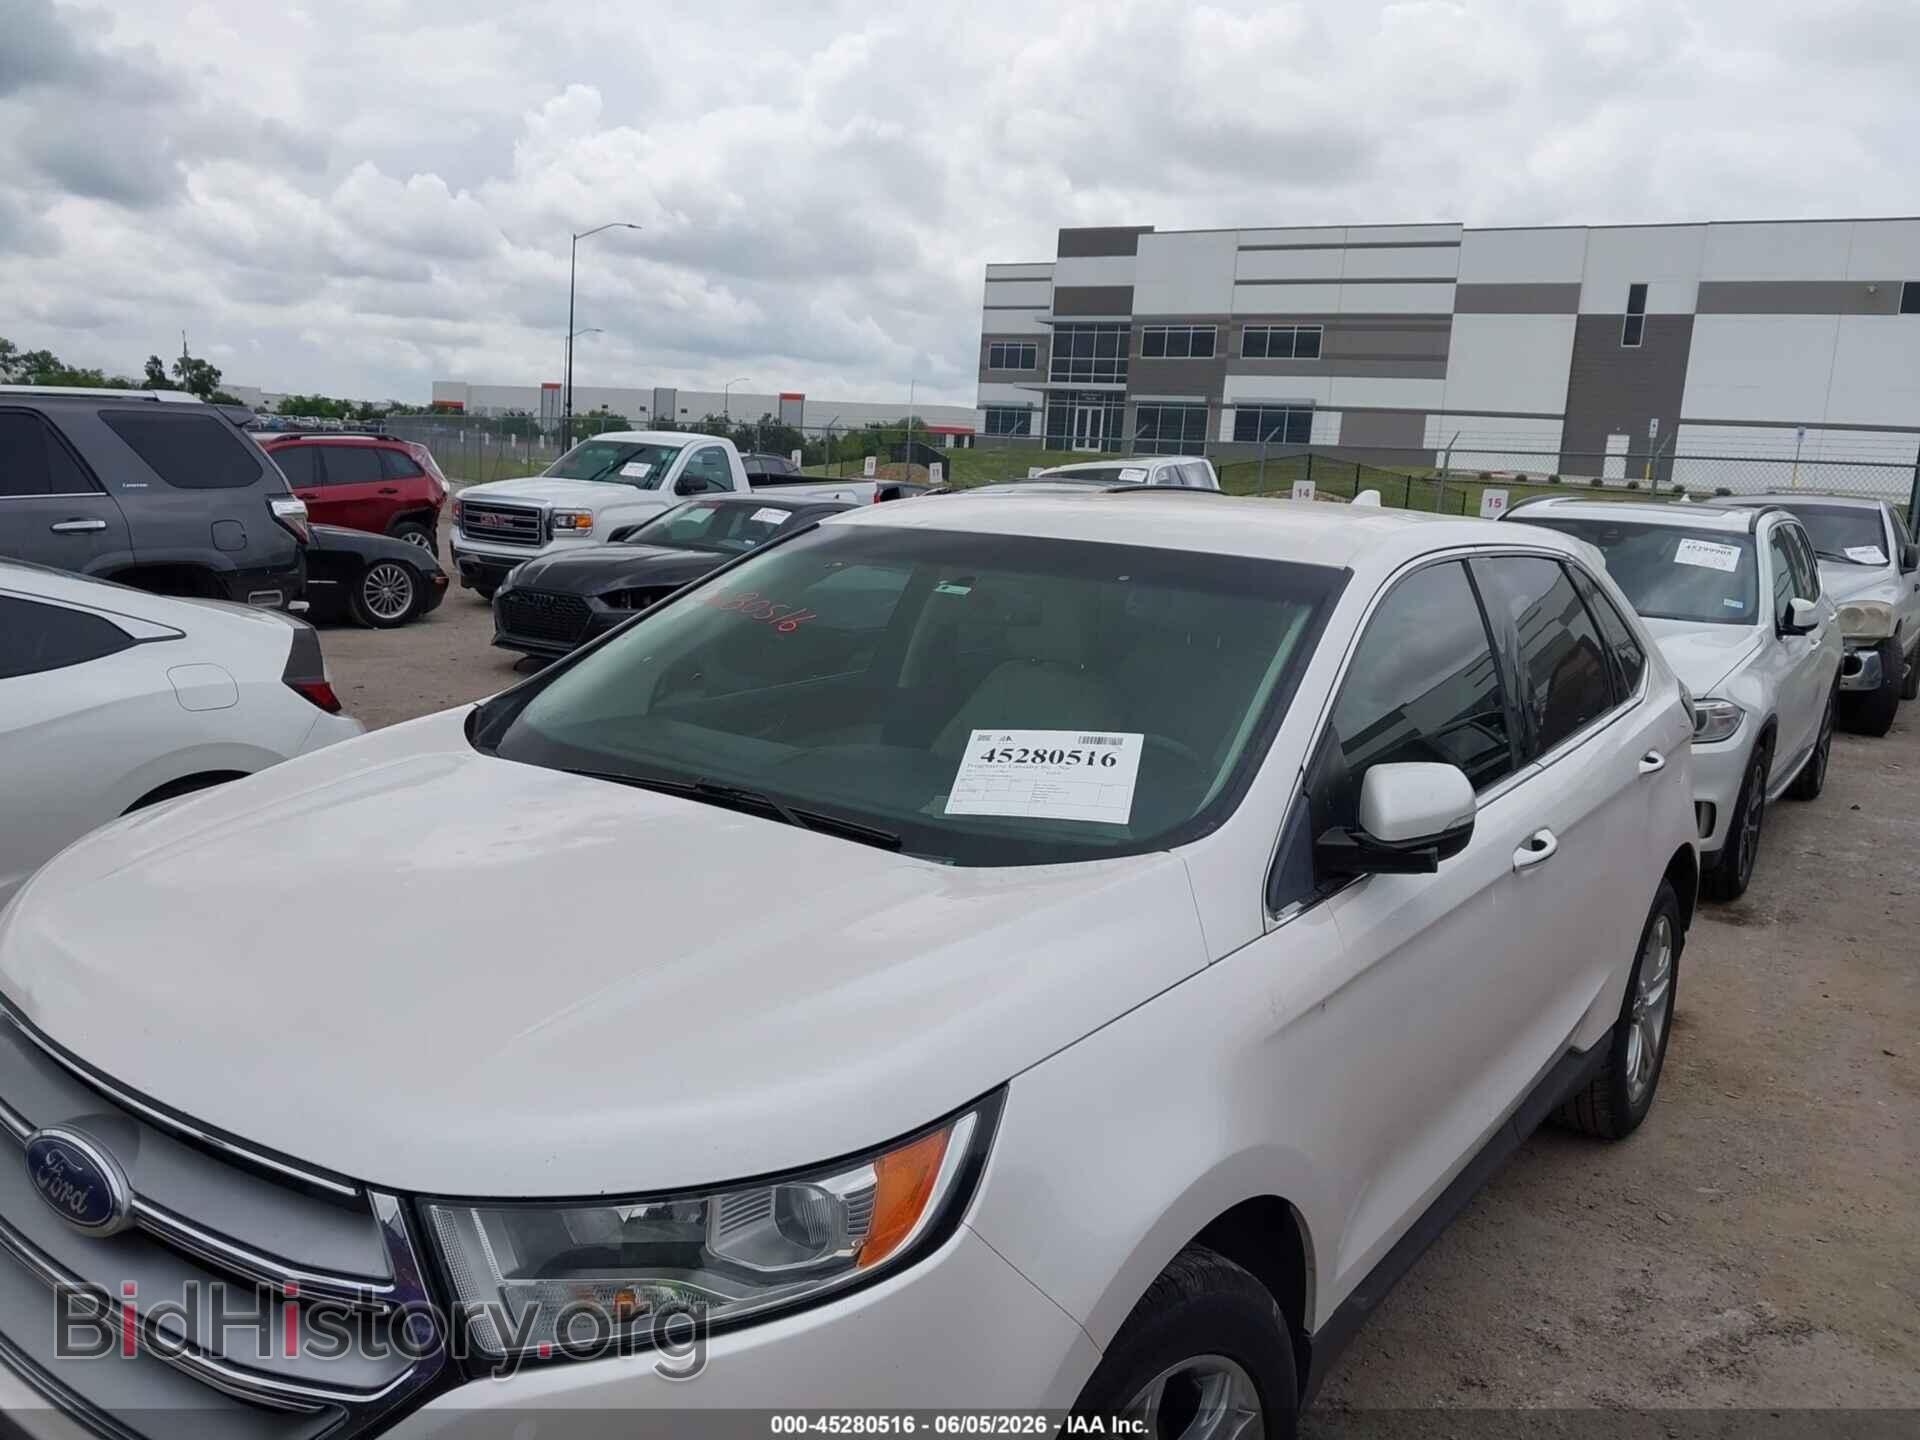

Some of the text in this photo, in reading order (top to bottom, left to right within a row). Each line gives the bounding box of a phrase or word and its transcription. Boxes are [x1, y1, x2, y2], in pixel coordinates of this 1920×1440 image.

[1297, 488, 1310, 498] 14
[1487, 498, 1502, 508] 15
[979, 747, 1118, 769] 45280516
[36, 1148, 93, 1215] Ford
